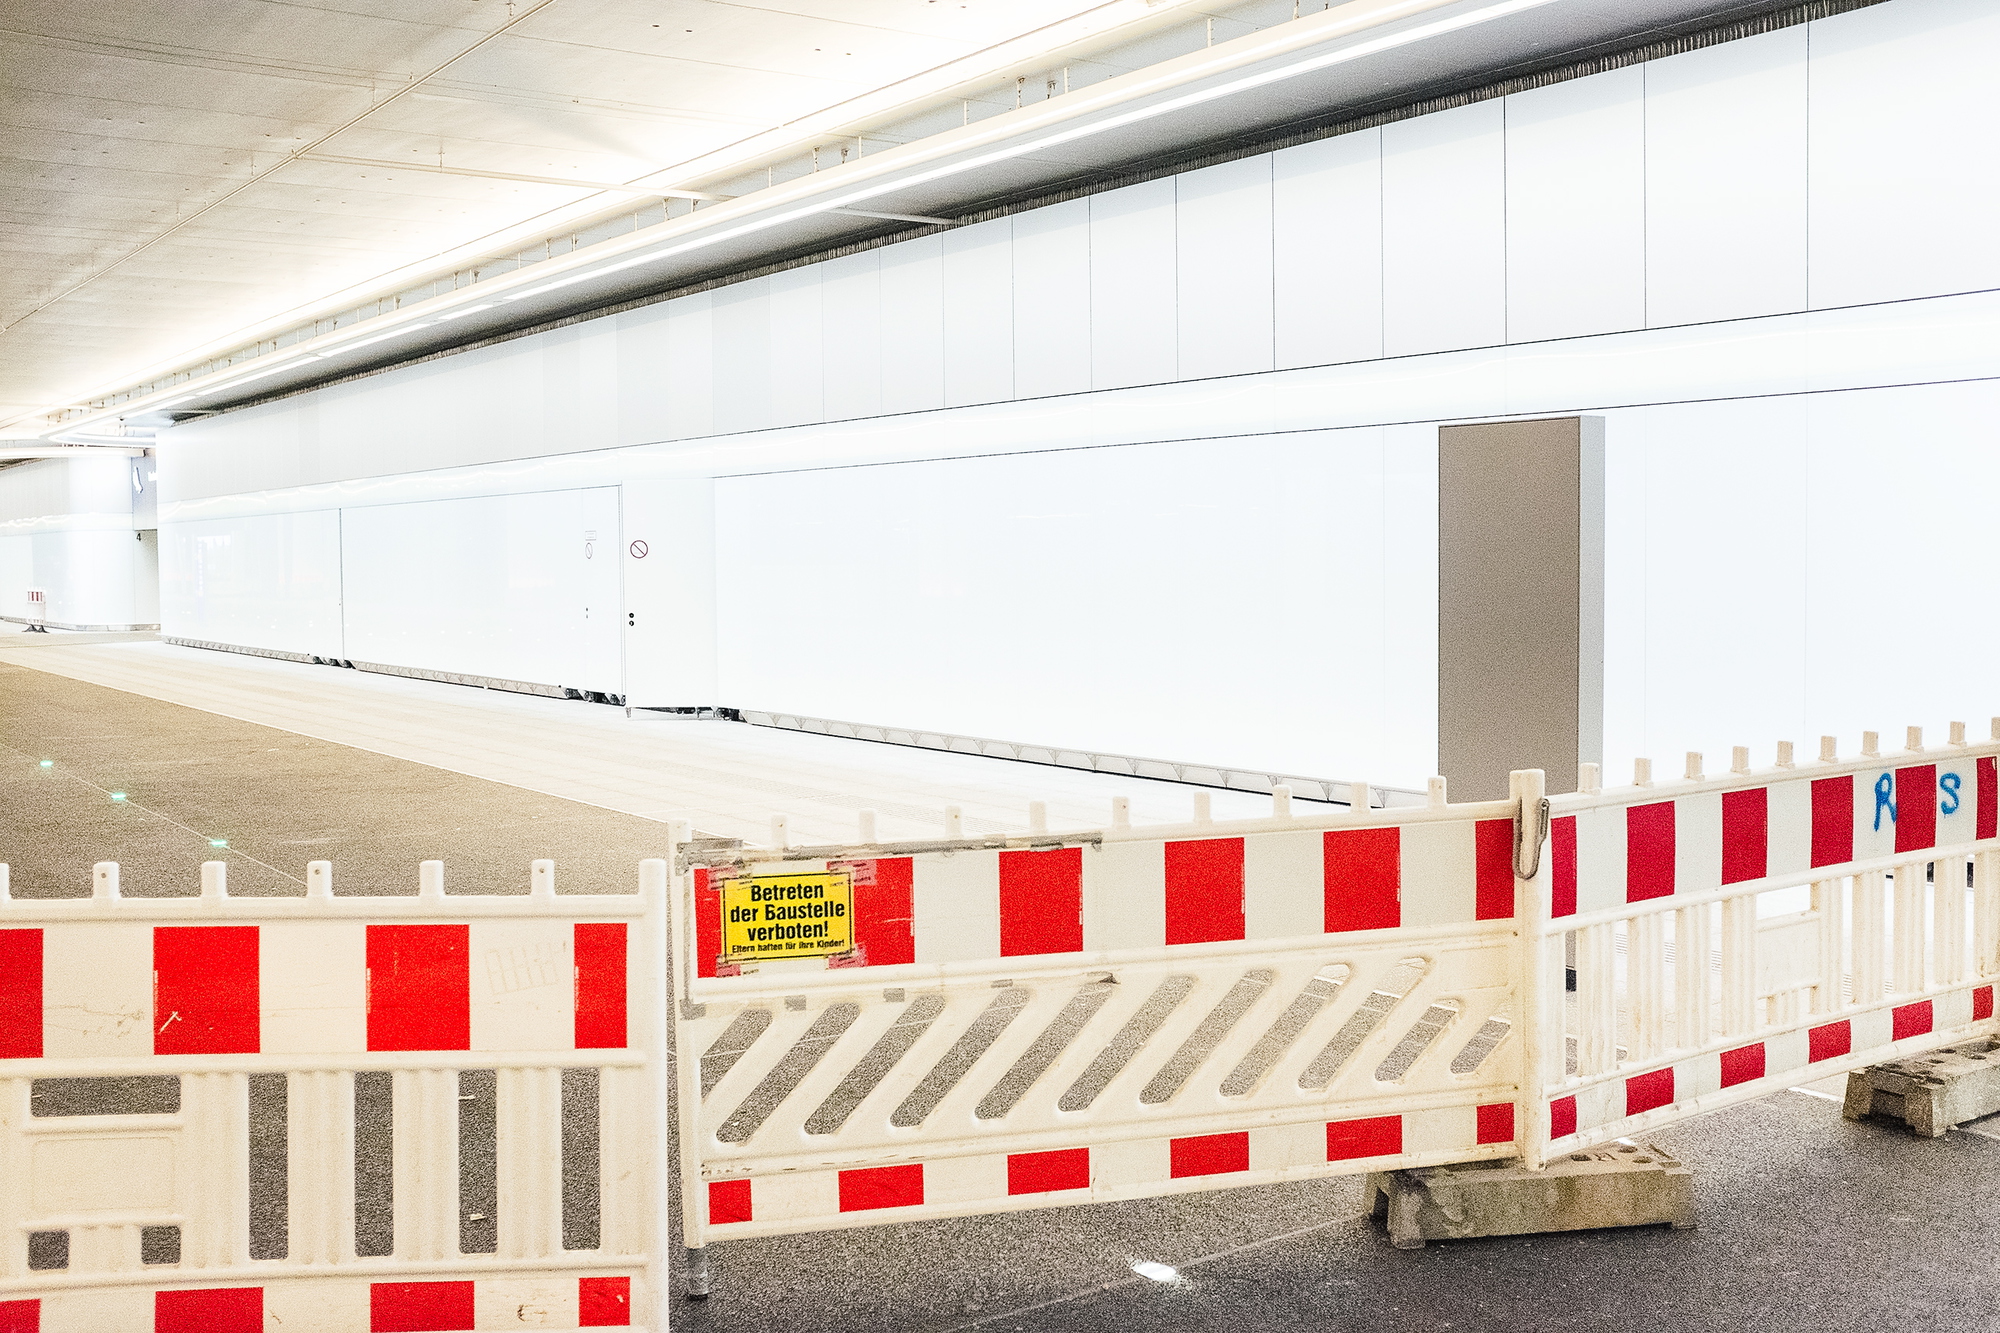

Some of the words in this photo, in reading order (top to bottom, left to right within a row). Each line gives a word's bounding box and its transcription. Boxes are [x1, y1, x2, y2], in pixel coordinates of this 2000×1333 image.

[750, 883, 824, 902] Betreten
[730, 905, 759, 923] der
[747, 920, 829, 941] verboten!
